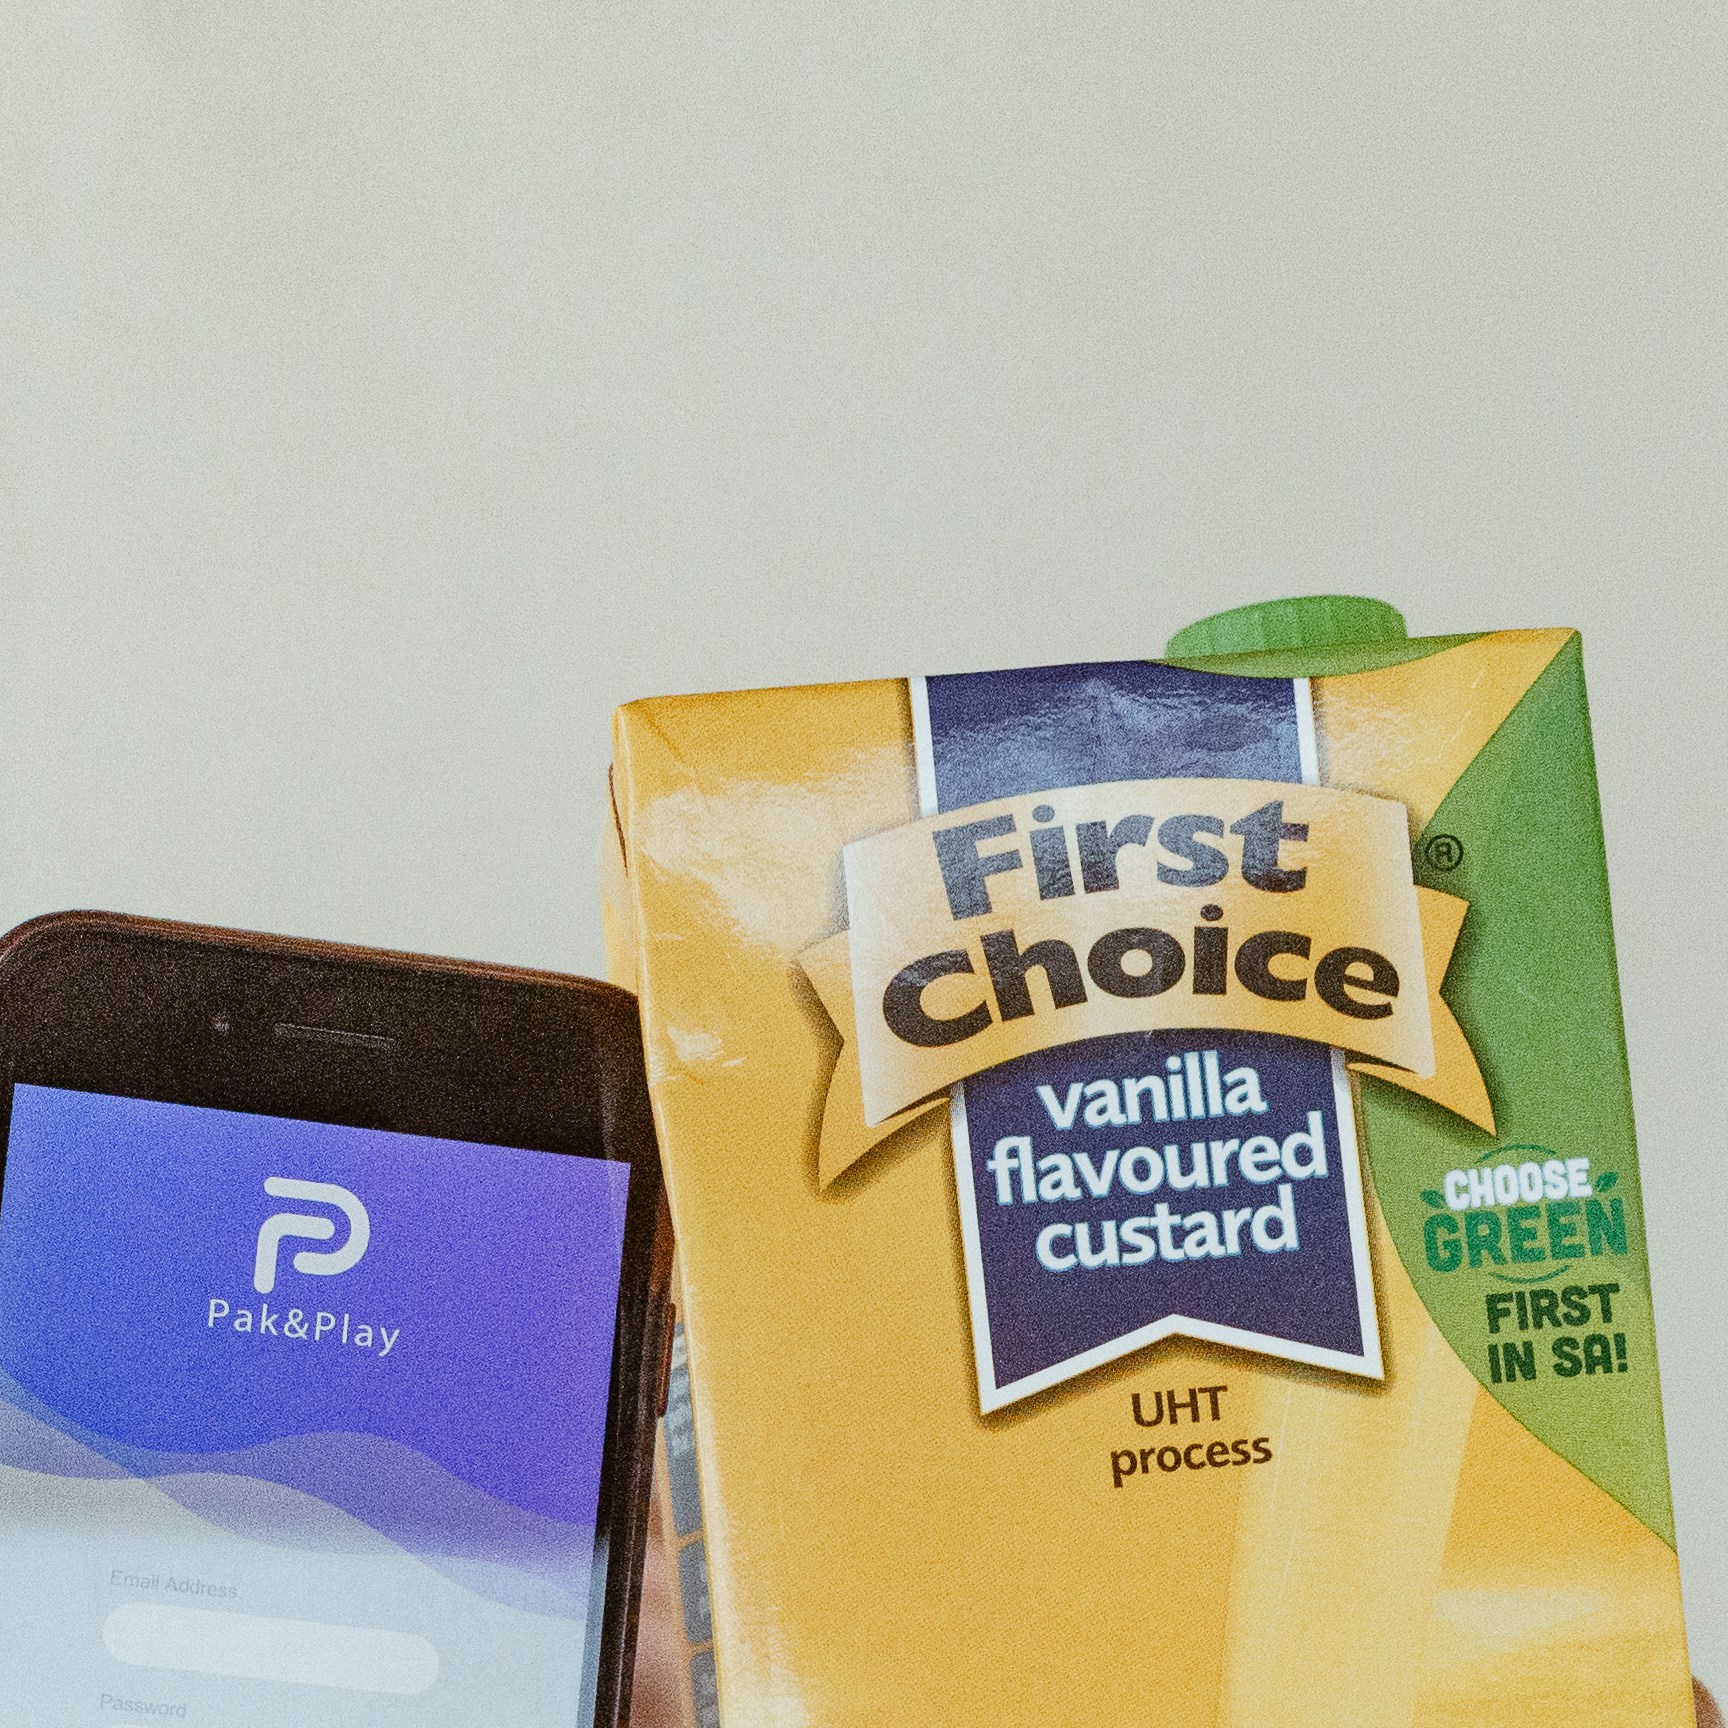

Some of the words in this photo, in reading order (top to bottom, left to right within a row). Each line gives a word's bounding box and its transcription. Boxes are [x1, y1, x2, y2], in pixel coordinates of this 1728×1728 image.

[933, 798, 1308, 919] First
[881, 904, 1401, 1047] Choice
[1036, 1050, 1266, 1130] vanilla
[988, 1111, 1328, 1205] flavoured
[1444, 1157, 1593, 1210] CHOOSE
[1037, 1184, 1300, 1272] custard
[1424, 1198, 1627, 1272] GREEN
[208, 1298, 400, 1358] Pak&Play
[1486, 1283, 1620, 1334] FIRST
[1488, 1340, 1536, 1384] IN
[1552, 1332, 1628, 1377] SA!
[1131, 1385, 1228, 1427] UHT
[1111, 1437, 1272, 1488] process
[110, 1569, 160, 1592] Email
[165, 1575, 238, 1598] Address
[99, 1694, 188, 1718] Password
